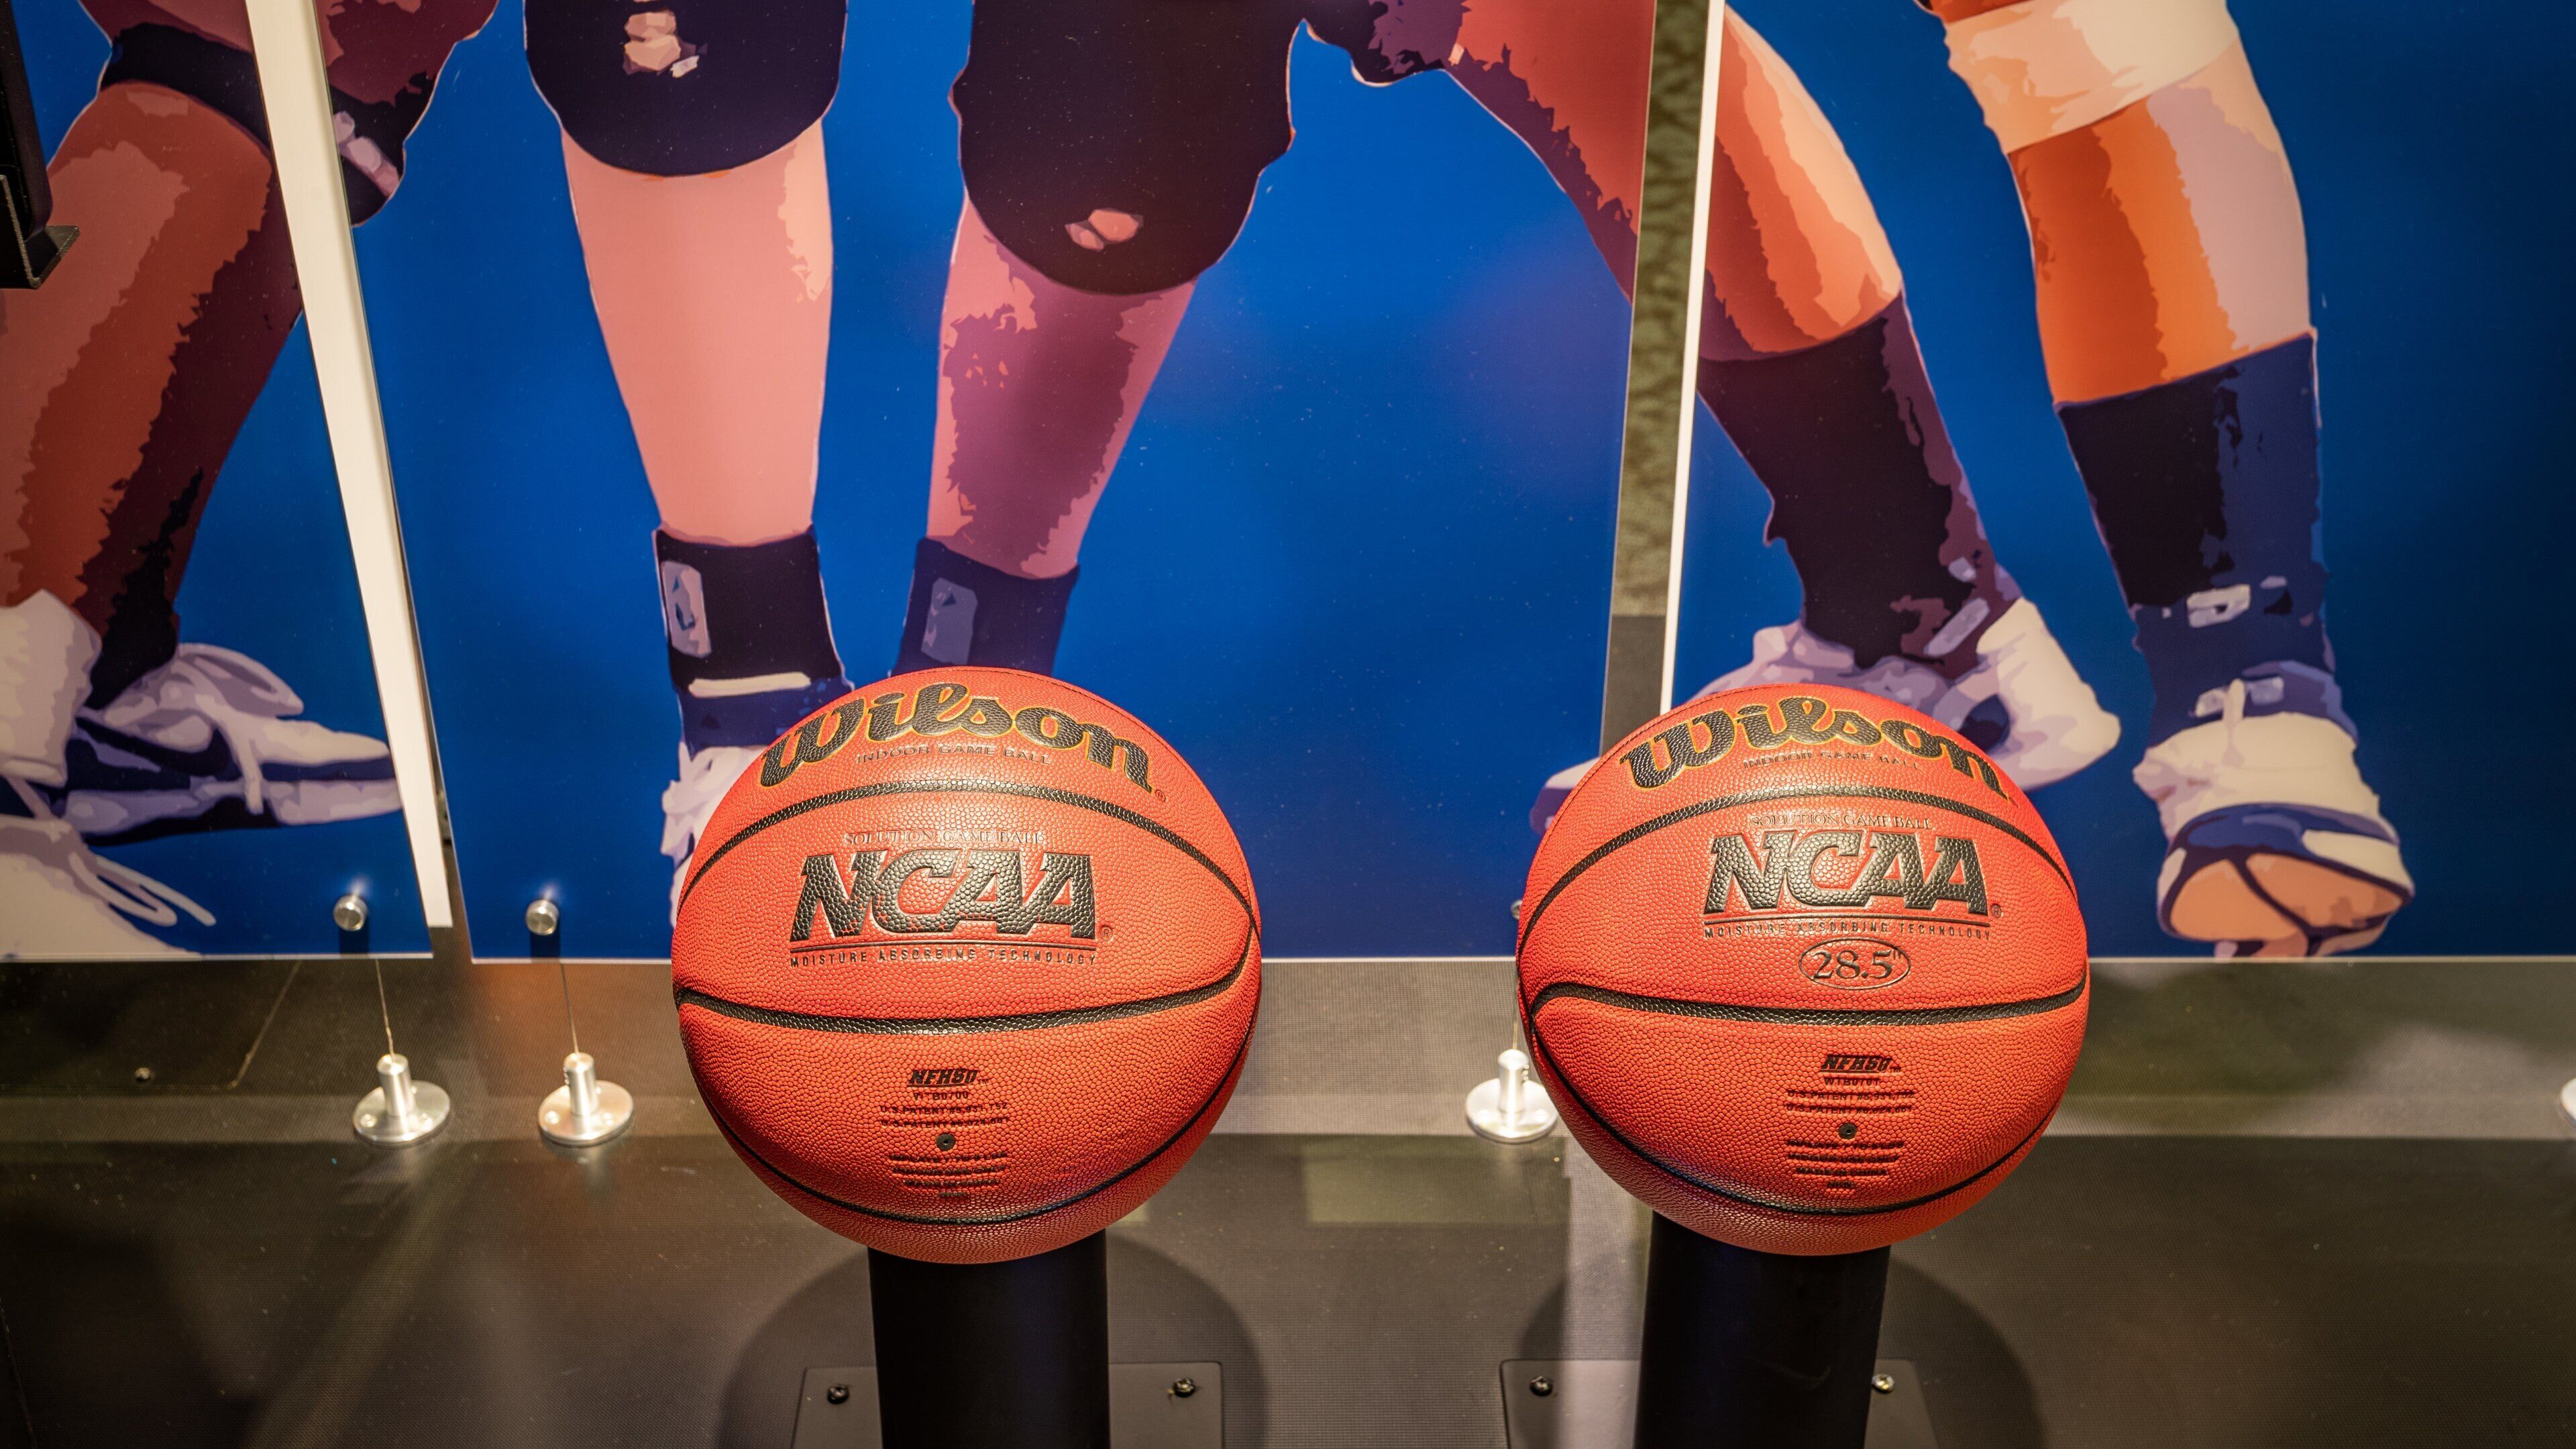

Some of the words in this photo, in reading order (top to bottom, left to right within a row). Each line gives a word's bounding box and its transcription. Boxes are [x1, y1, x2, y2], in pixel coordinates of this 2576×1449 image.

[759, 682, 1154, 794] Wilson
[857, 745, 930, 764] INDOOR
[939, 745, 996, 756] GAME
[1002, 749, 1052, 765] BALL
[1620, 696, 2009, 801] Wilson
[1743, 753, 1812, 769] INDOOR
[1819, 751, 1872, 761] GAME
[1879, 756, 1923, 770] BALL
[1750, 814, 1839, 826] SOLUTION
[1843, 814, 1889, 827] GAME
[1889, 816, 1933, 830] BALL
[843, 829, 936, 846] SOLUTION
[943, 829, 996, 843] GAME
[999, 830, 1045, 845] BALL
[1703, 829, 1989, 915] NCAA
[790, 849, 1097, 941] NCAA
[1703, 923, 1786, 938] MOISTURE
[1798, 922, 1888, 933] ABSORBING
[1900, 924, 1992, 941] TECHNOLOGY
[790, 951, 867, 968] MOISTURE
[878, 947, 976, 961] ABSORBING
[988, 947, 1097, 966] TECHNOLOGY
